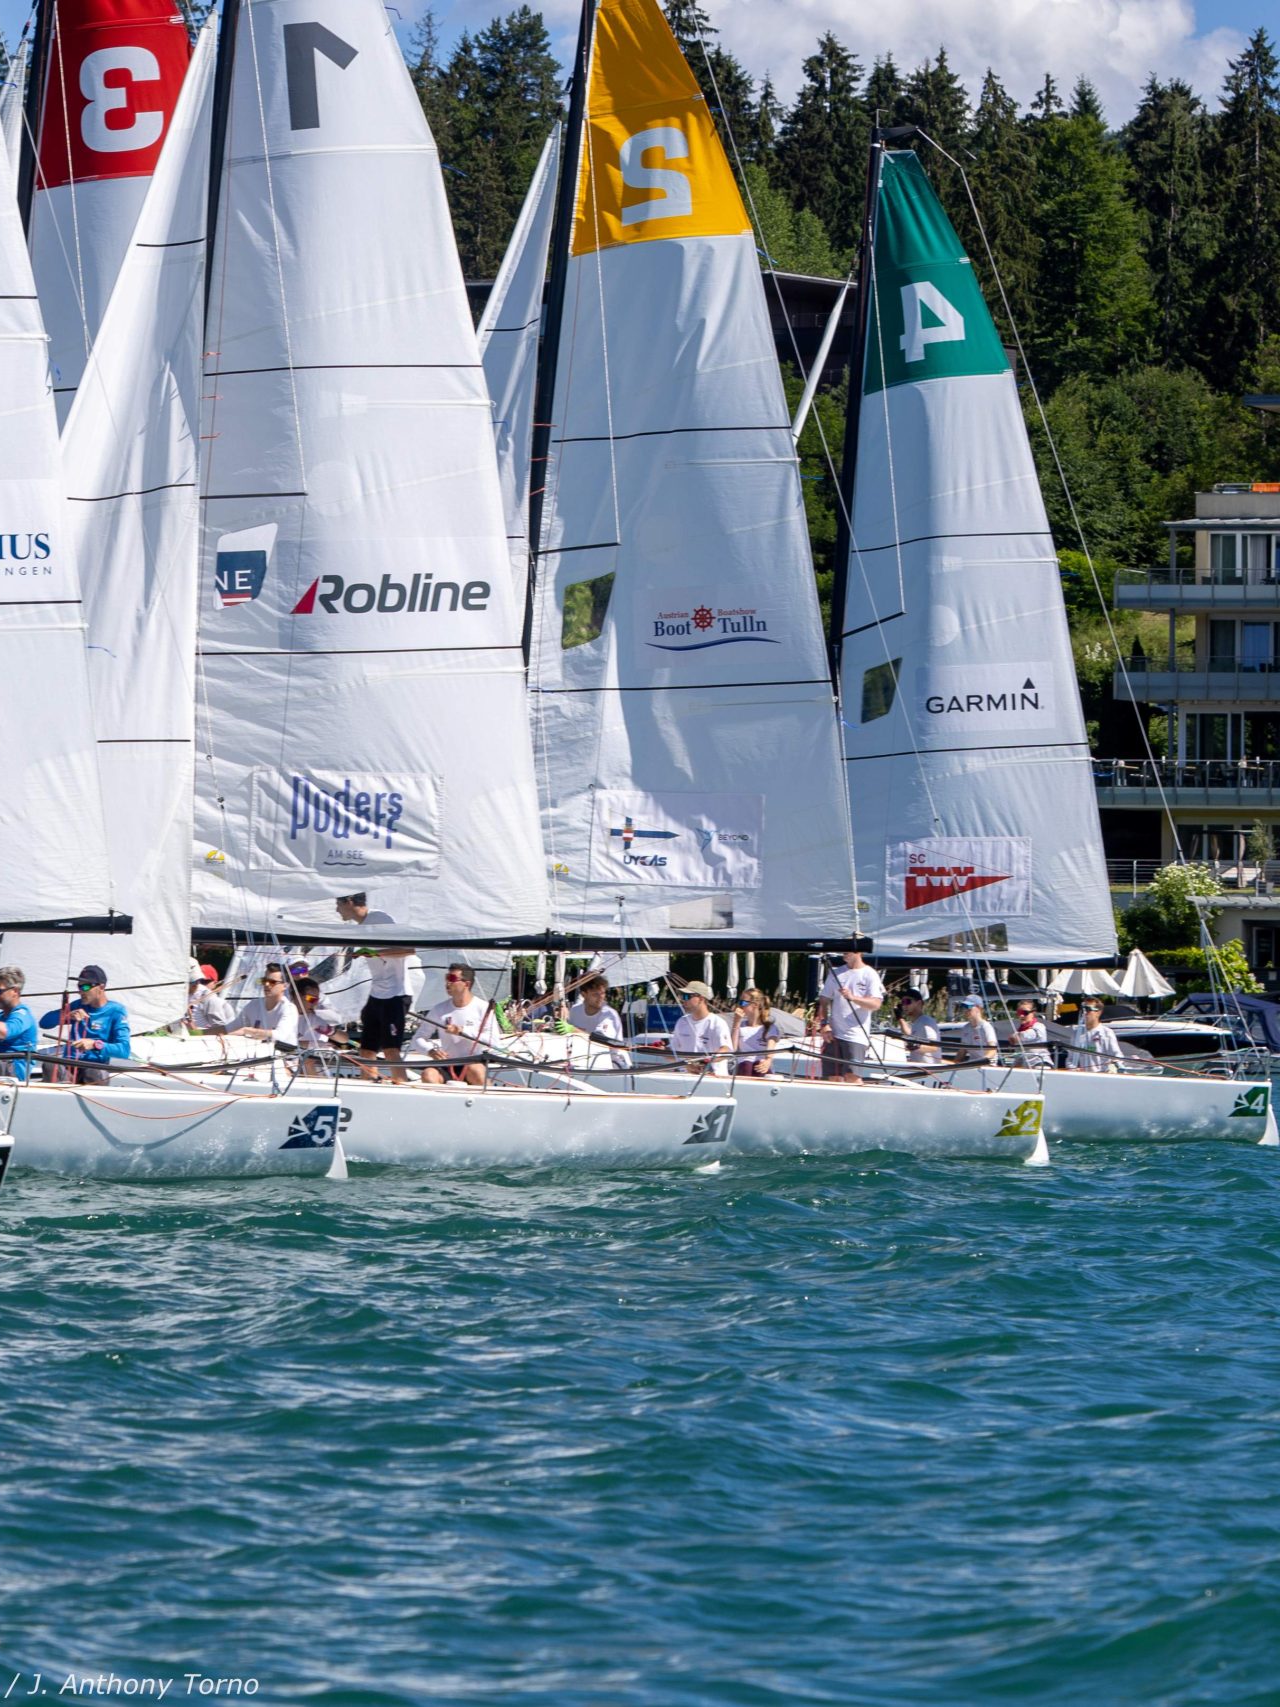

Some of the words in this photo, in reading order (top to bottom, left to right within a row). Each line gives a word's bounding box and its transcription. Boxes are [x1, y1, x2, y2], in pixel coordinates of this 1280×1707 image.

[318, 573, 491, 614] Robline
[653, 620, 692, 637] Boot
[717, 615, 768, 634] Tulln
[925, 692, 1040, 714] GARMIN
[909, 853, 926, 864] SC
[1251, 1087, 1266, 1115] 4
[310, 1115, 335, 1144] 5
[713, 1112, 727, 1143] 1
[1019, 1108, 1039, 1136] 2
